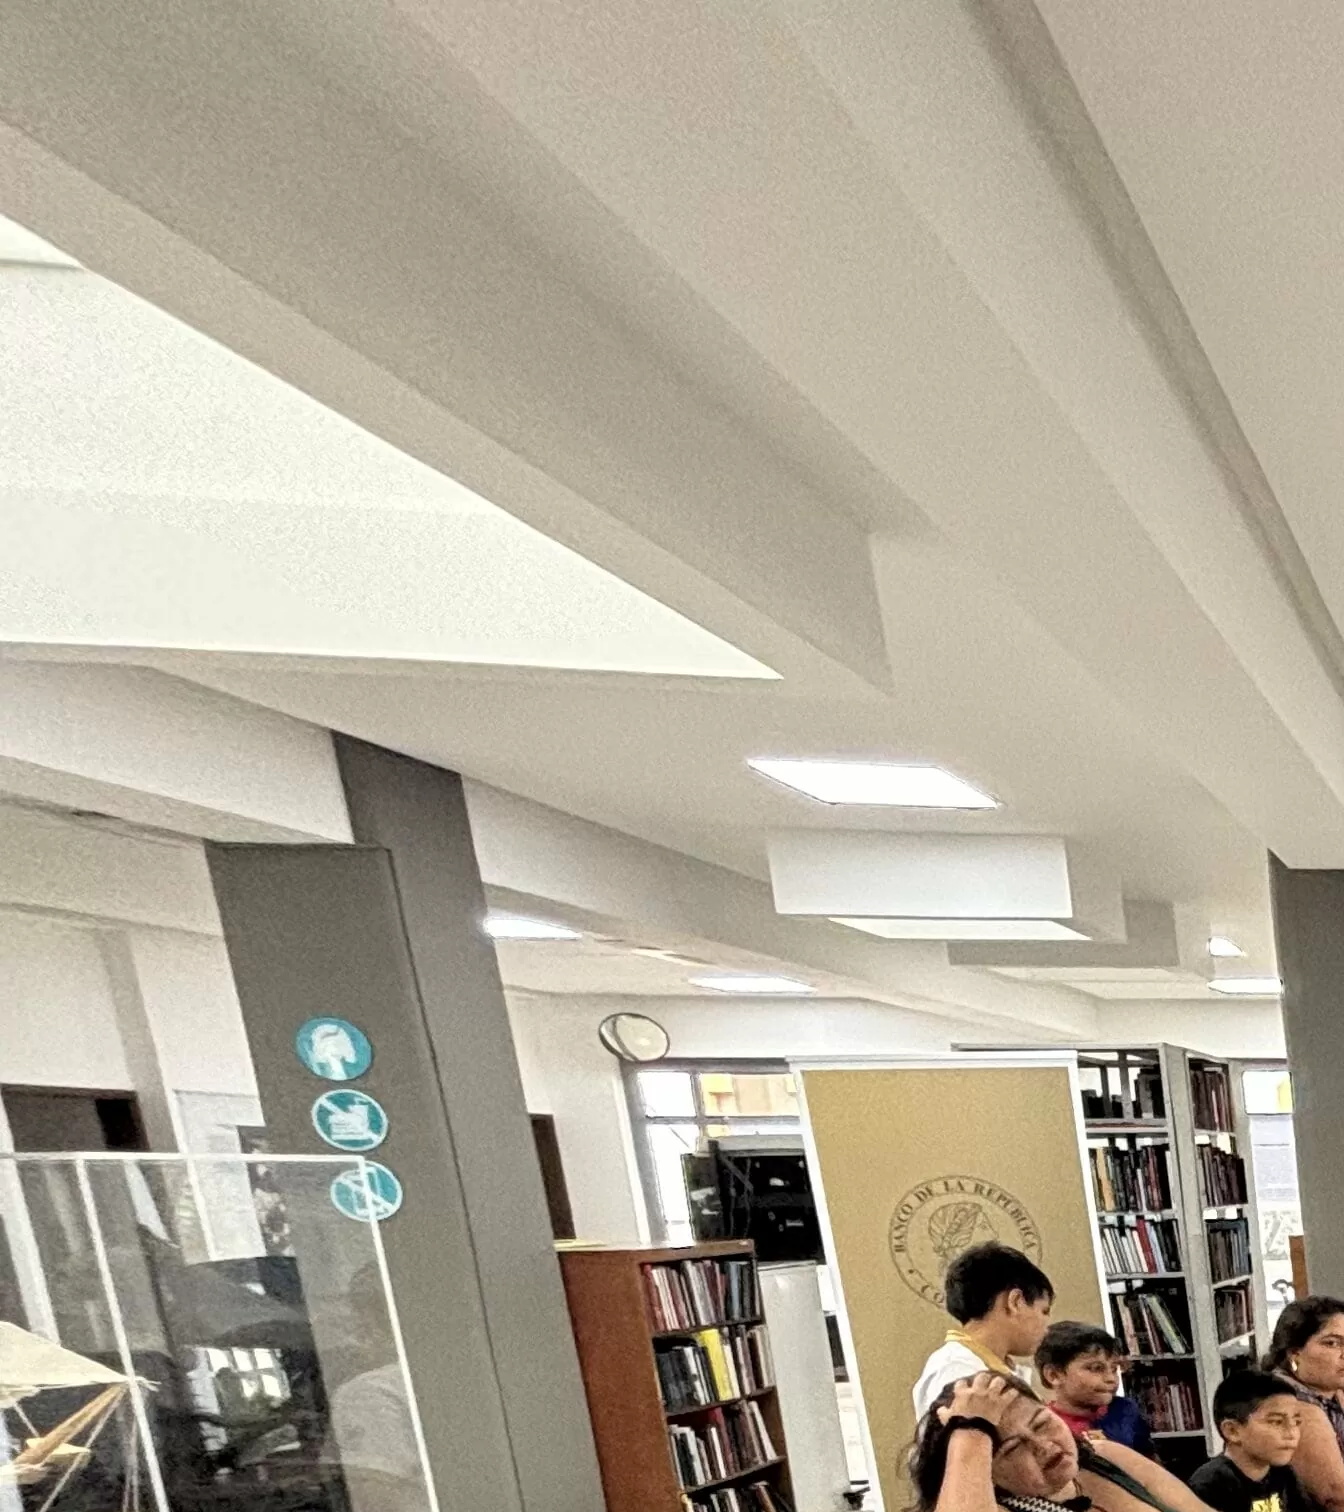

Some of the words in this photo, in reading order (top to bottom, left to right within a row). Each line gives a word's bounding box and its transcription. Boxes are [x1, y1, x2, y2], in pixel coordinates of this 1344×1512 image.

[893, 1203, 914, 1253] BANCO
[914, 1186, 934, 1203] DE
[943, 1180, 967, 1193] LA
